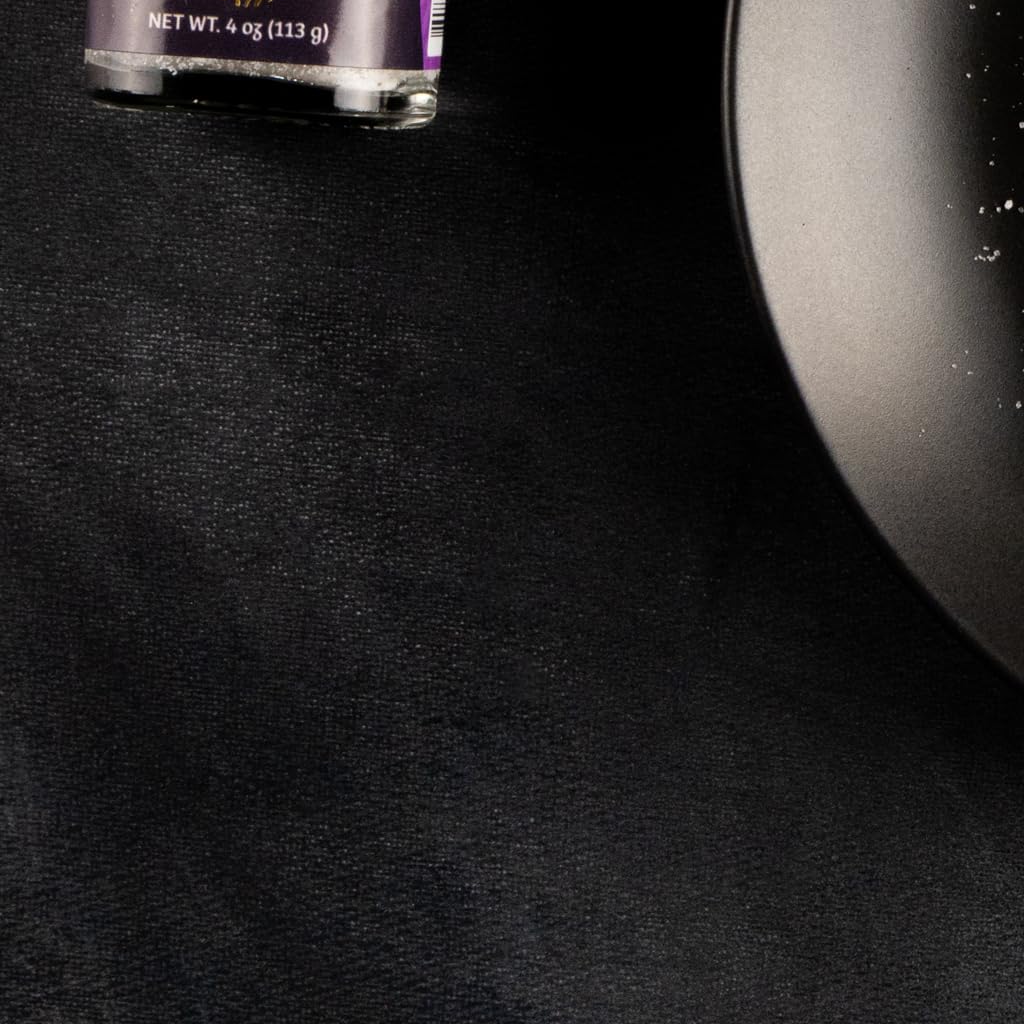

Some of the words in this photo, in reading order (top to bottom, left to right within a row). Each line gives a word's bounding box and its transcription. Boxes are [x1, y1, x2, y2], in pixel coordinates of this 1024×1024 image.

[148, 12, 184, 30] NET
[189, 15, 220, 34] WT.
[226, 18, 237, 34] 4
[242, 22, 263, 41] oz
[268, 21, 306, 41] (113
[310, 24, 329, 45] g)
